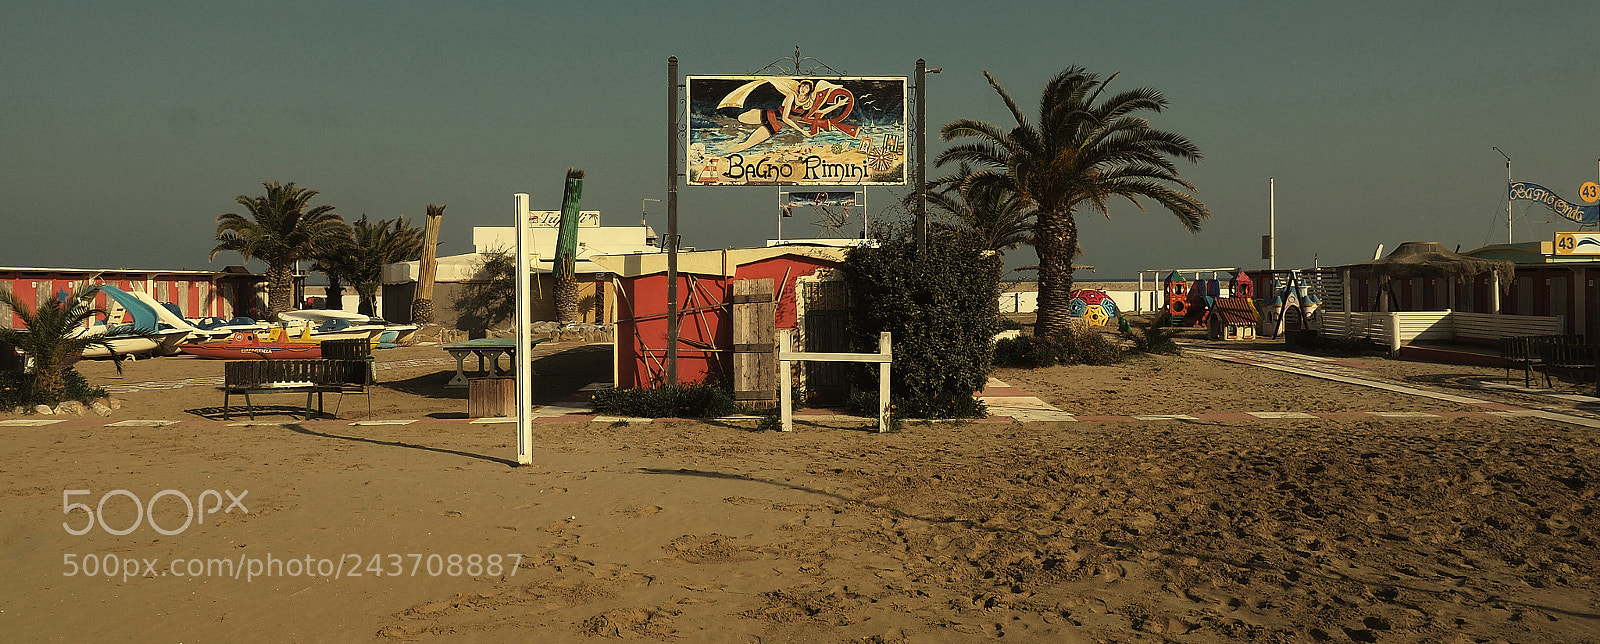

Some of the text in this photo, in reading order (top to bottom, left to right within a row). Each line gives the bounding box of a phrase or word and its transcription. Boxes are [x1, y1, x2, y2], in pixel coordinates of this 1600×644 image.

[797, 88, 860, 138] 42
[800, 155, 869, 184] Rimini
[1510, 183, 1584, 221] Bagno Onda
[1582, 185, 1597, 198] 43
[541, 212, 587, 227] Trili
[1558, 237, 1574, 249] 43
